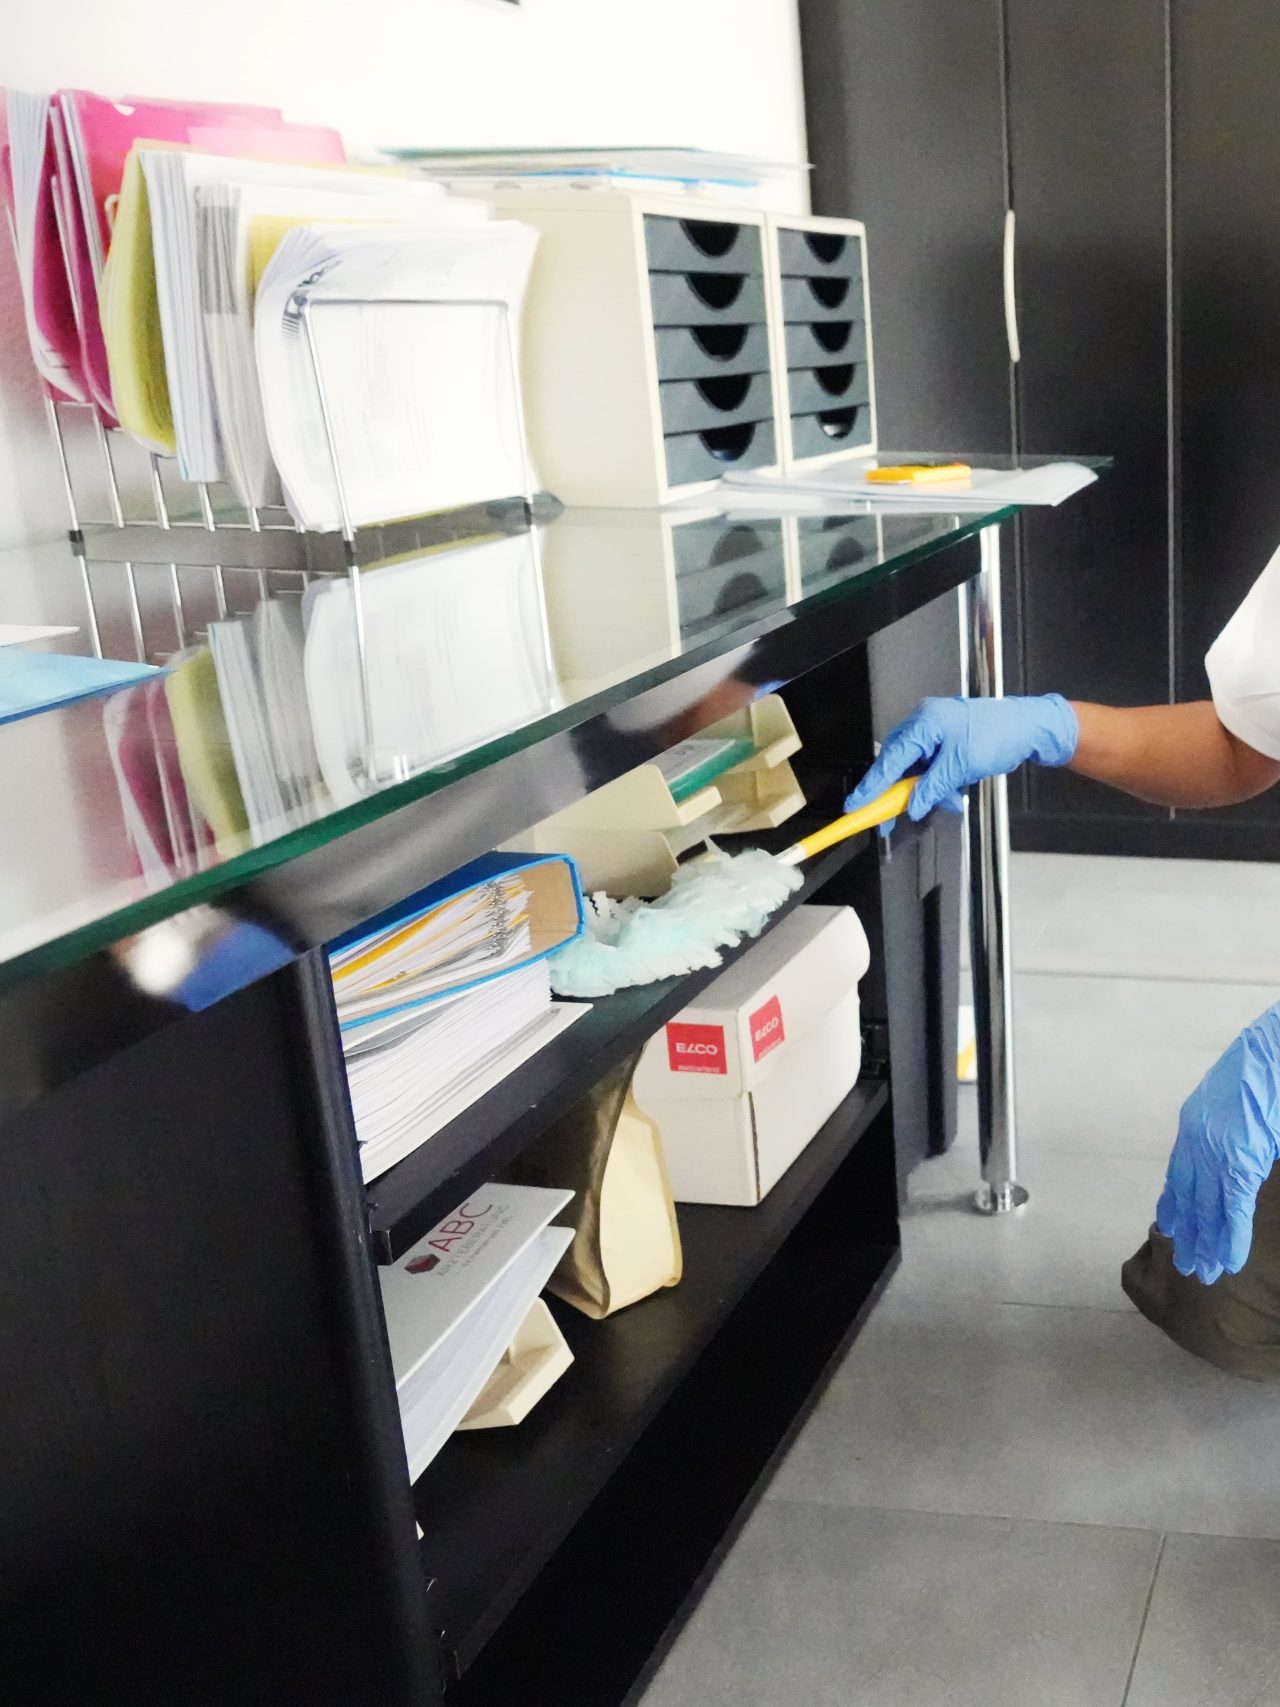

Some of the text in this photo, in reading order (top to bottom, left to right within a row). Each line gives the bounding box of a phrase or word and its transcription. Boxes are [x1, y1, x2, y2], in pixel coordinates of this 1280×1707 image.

[755, 1016, 779, 1041] ELCO
[675, 1042, 718, 1055] ELCO
[428, 1203, 493, 1252] ABC
